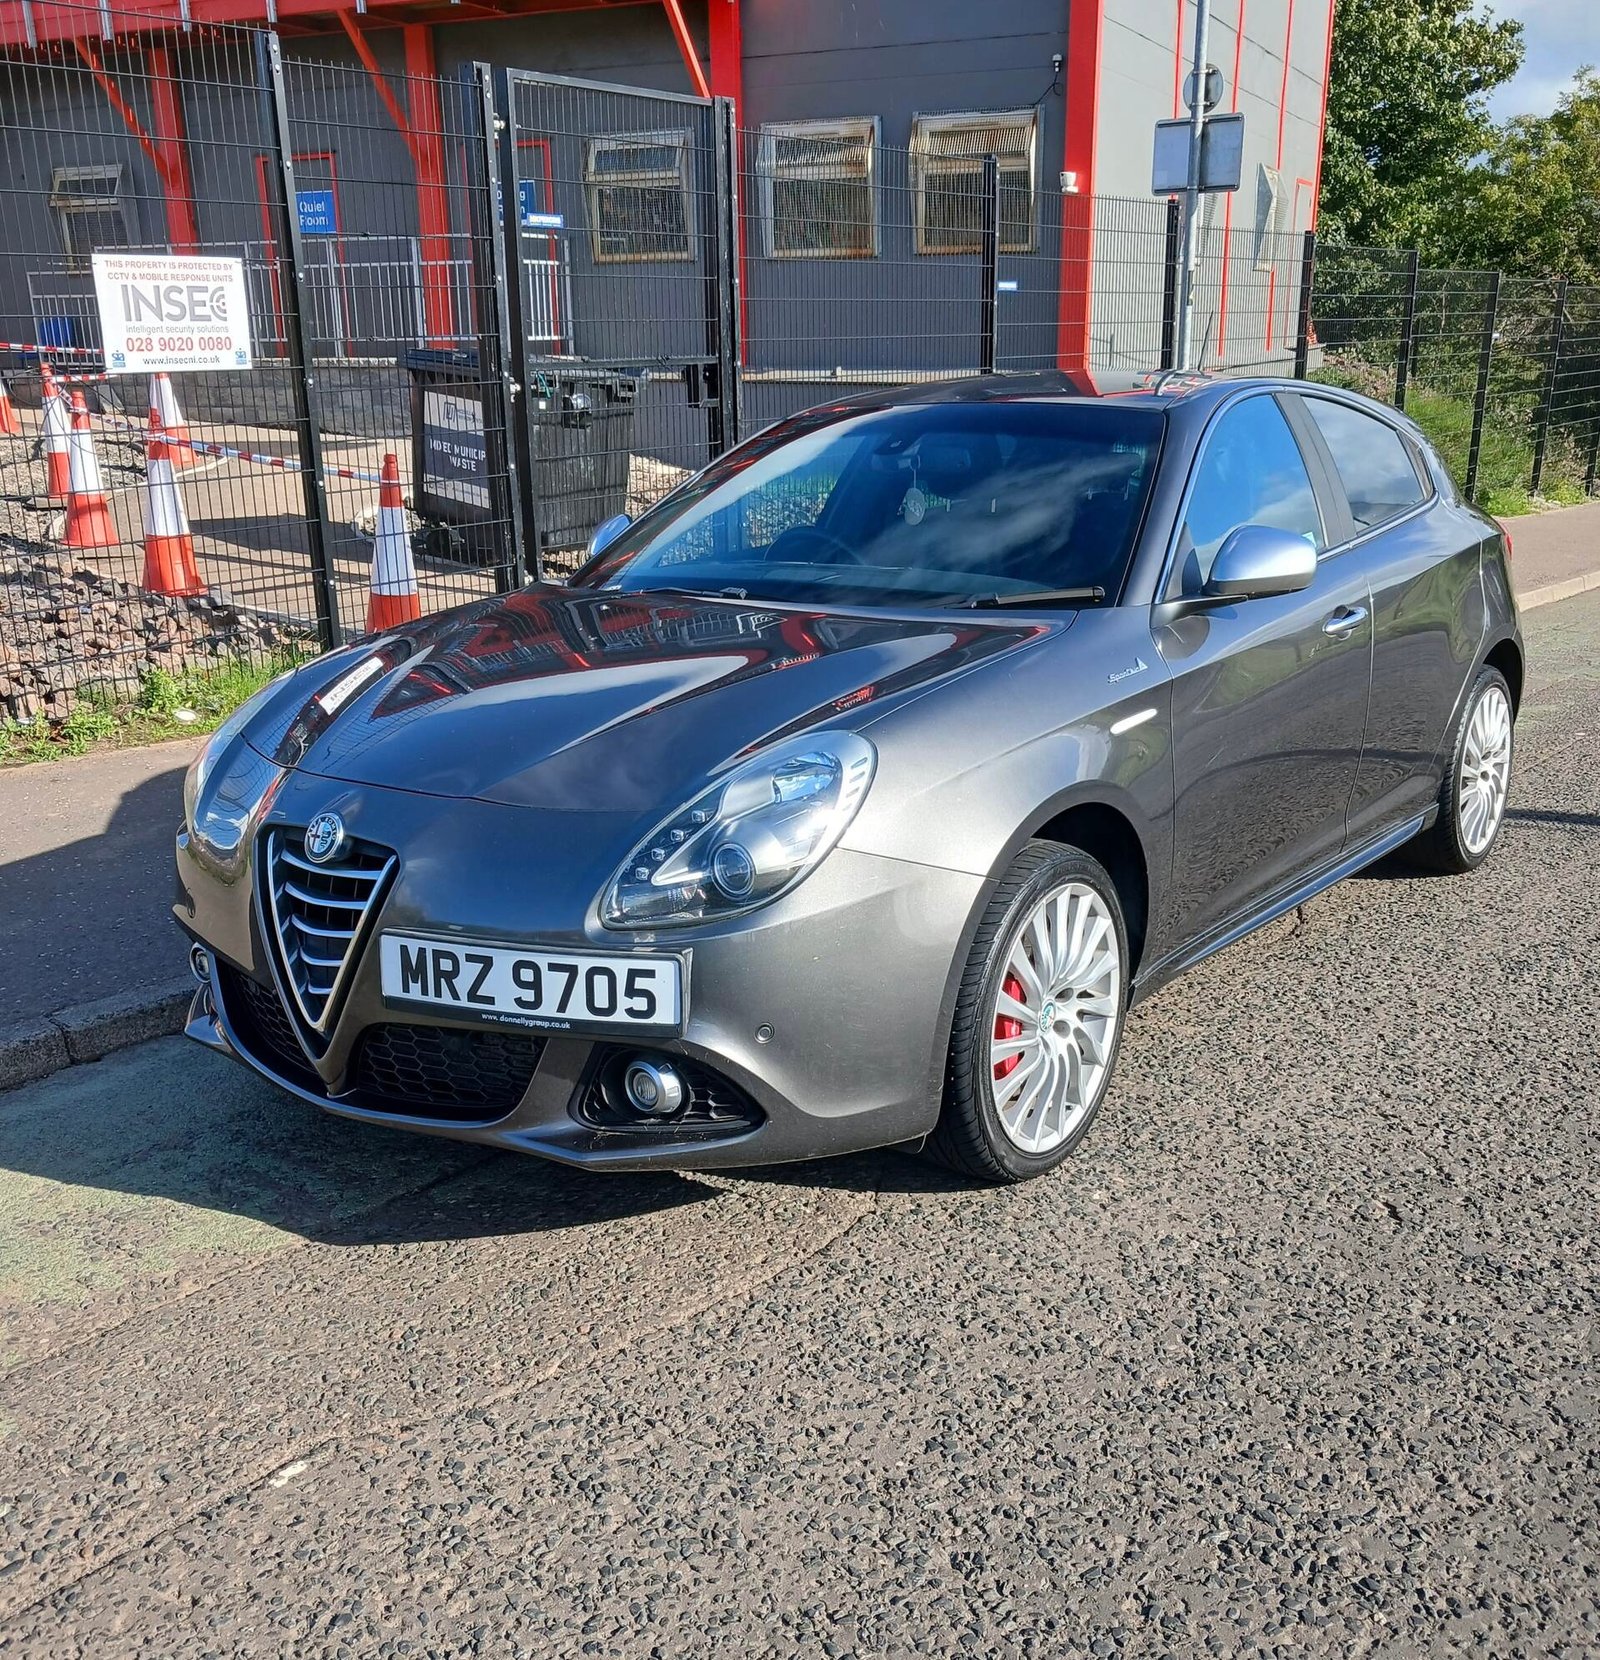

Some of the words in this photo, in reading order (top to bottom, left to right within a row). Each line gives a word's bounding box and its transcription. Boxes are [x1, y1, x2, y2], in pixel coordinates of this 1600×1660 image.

[299, 200, 325, 213] Quiet
[300, 215, 329, 226] Room
[105, 260, 123, 268] THIS
[125, 261, 166, 269] PROPERTY
[178, 262, 221, 270] PROTECTED
[223, 263, 233, 271] BY
[107, 272, 129, 280] CCTV
[139, 273, 169, 281] MOBILE
[170, 274, 211, 282] RESPONSE
[121, 284, 227, 322] INSEC
[165, 325, 195, 335] security
[196, 325, 229, 333] solutions
[126, 337, 154, 352] 028
[158, 336, 194, 351] 9020
[198, 336, 232, 351] 0080
[143, 356, 220, 365] www.insecni.co.uk
[449, 455, 476, 471] WASTE
[400, 944, 496, 1006] MRZ
[511, 959, 657, 1020] 9705
